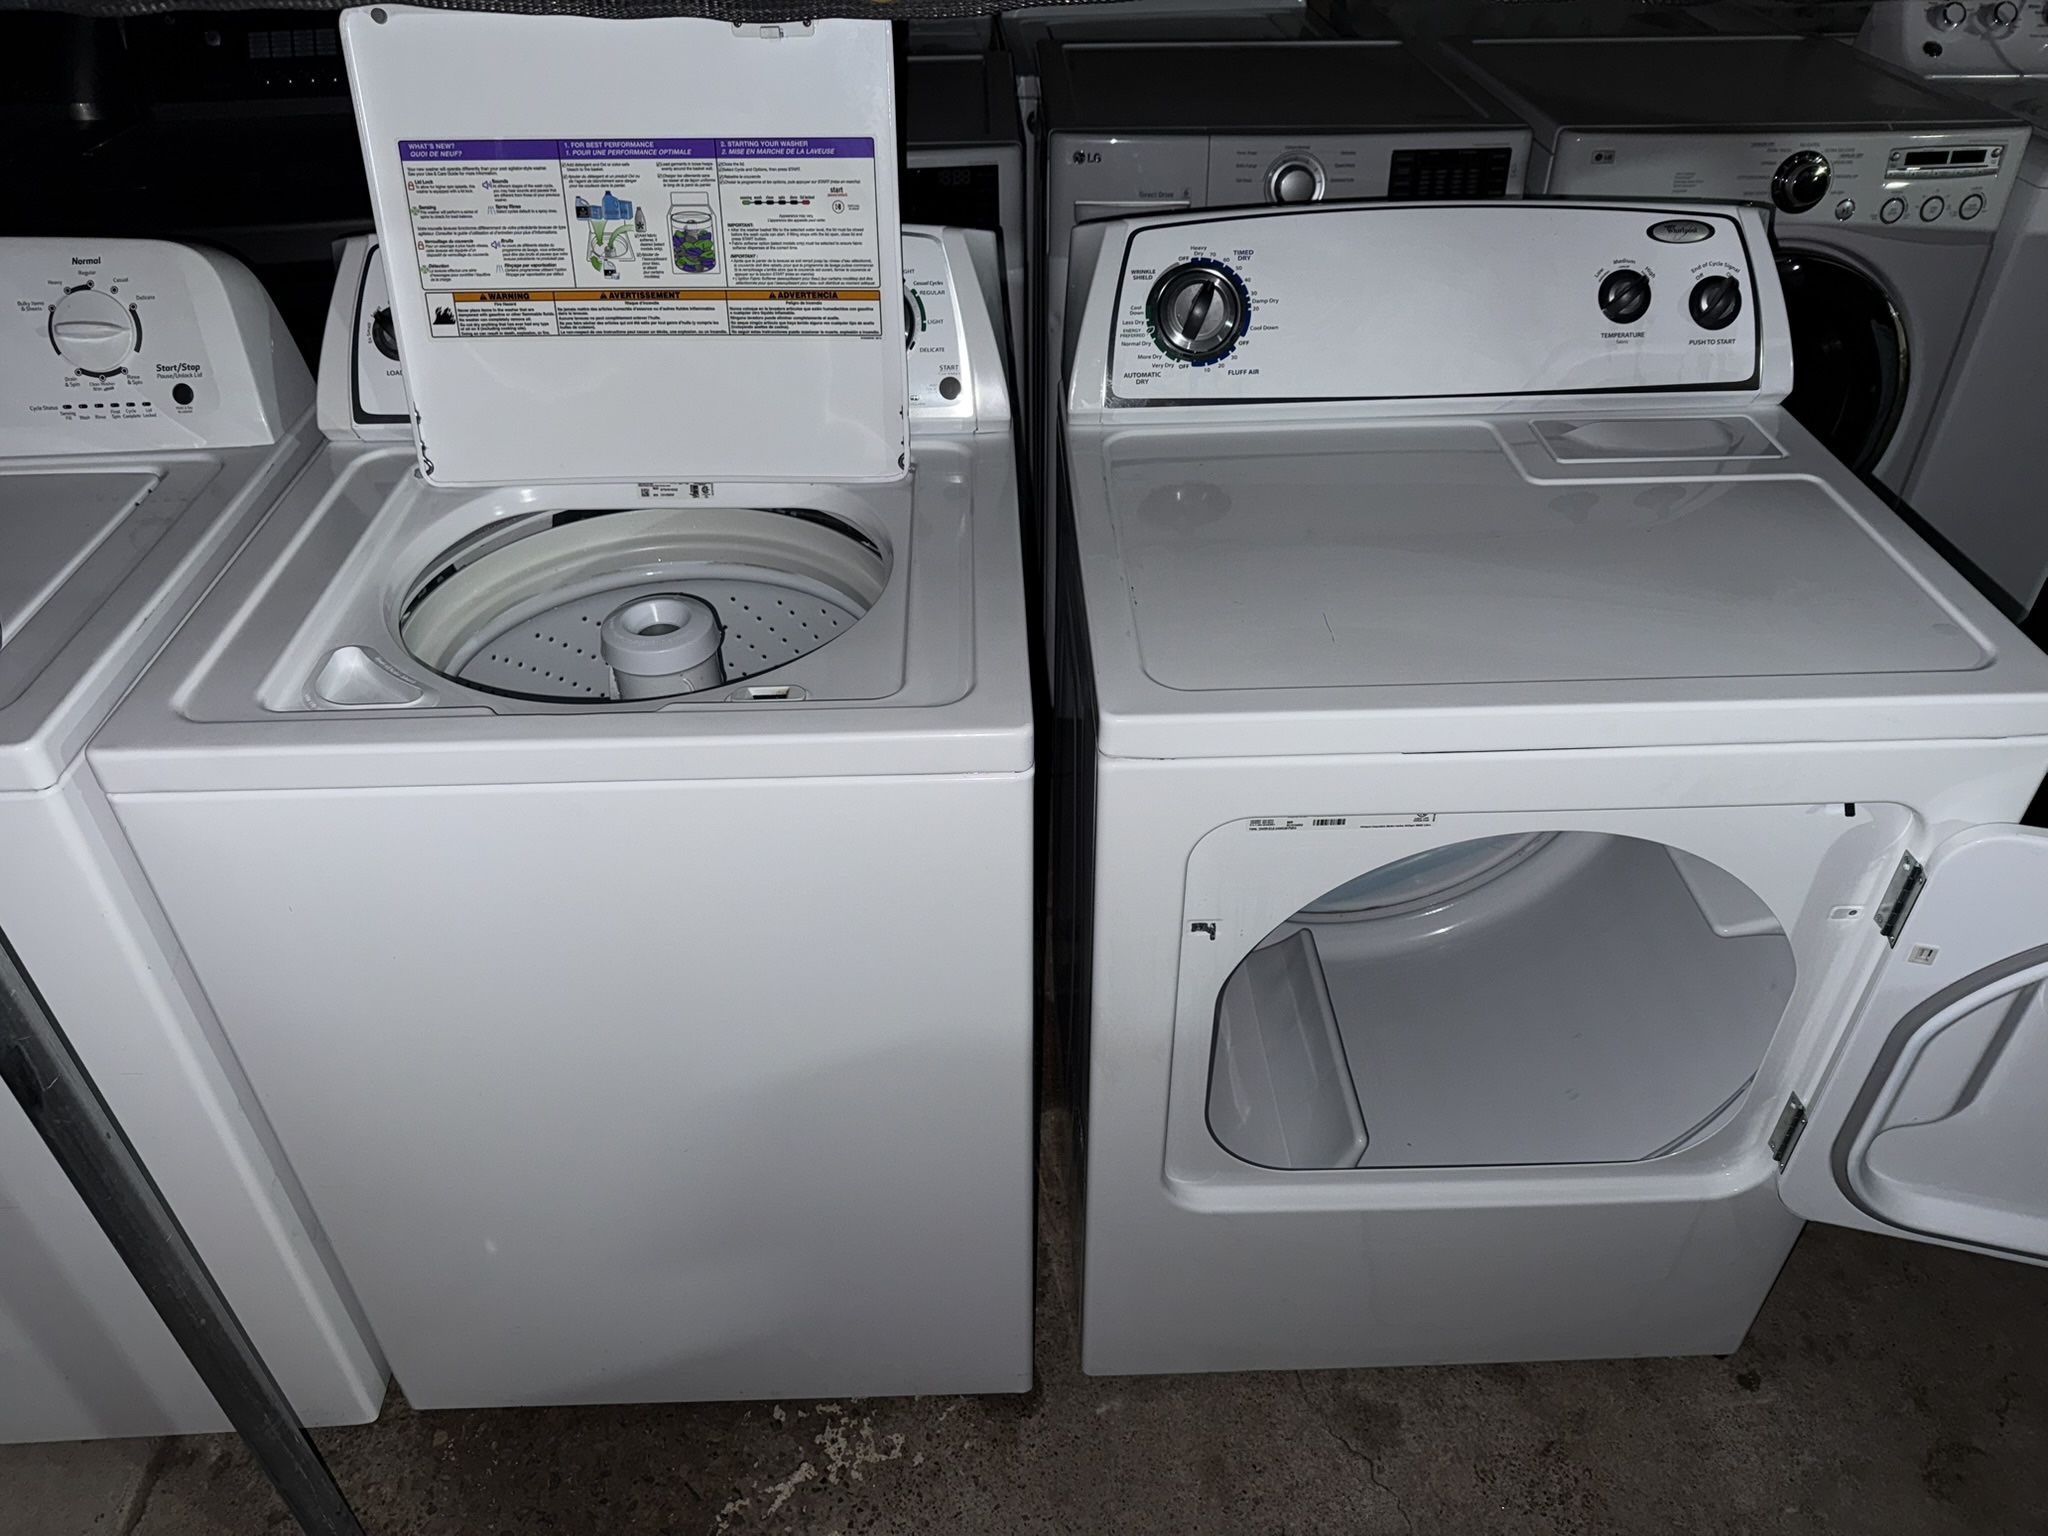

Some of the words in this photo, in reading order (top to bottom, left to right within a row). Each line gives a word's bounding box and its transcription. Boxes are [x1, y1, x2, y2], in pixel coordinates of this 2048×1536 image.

[1665, 224, 1697, 235] Whirlpool
[72, 257, 101, 265] Normal
[1691, 264, 1701, 273] End
[1724, 262, 1740, 273] Signal
[156, 363, 200, 373] Start/Stop
